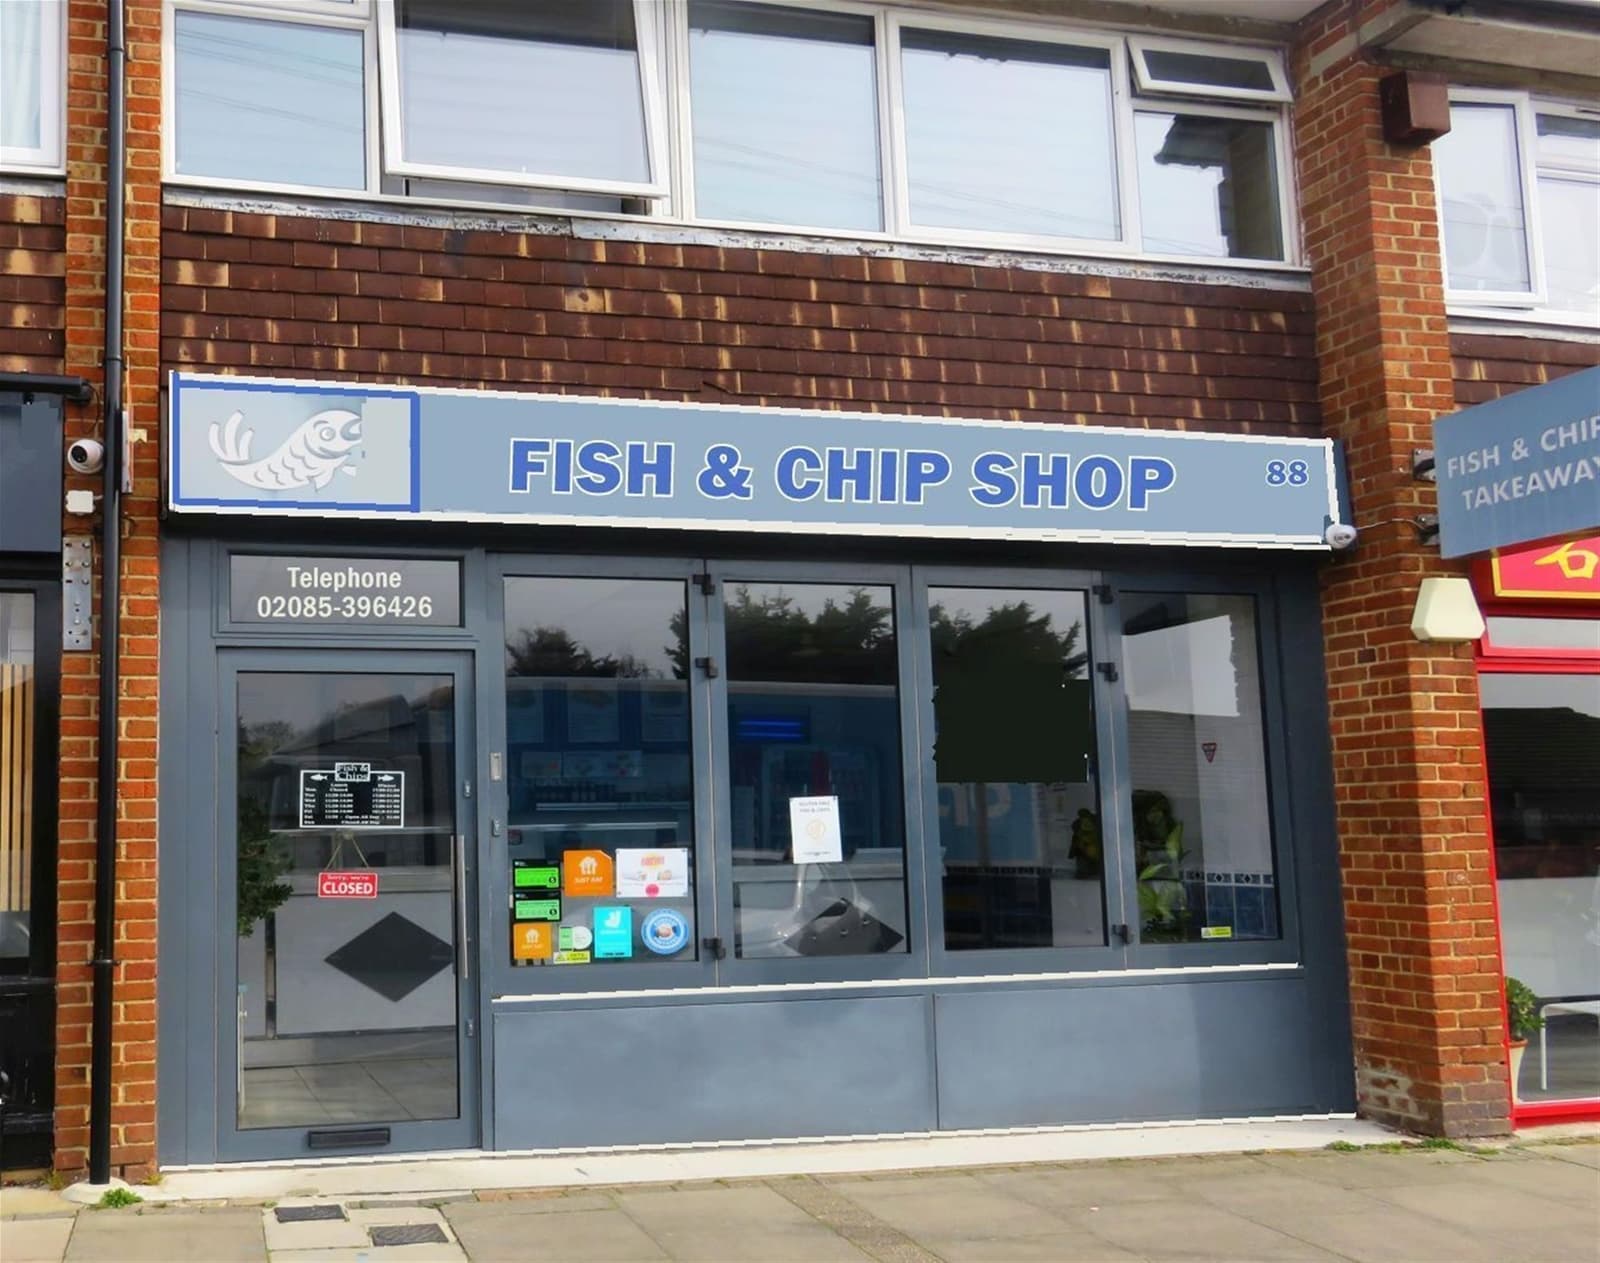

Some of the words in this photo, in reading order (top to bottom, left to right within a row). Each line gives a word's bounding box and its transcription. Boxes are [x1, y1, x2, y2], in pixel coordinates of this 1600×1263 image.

[1447, 445, 1500, 479] FISH
[1511, 437, 1530, 461] &
[509, 438, 675, 498] FISH
[696, 443, 753, 500] &
[775, 445, 952, 505] CHIP
[968, 451, 1176, 512] SHOP
[1264, 459, 1310, 488] 88
[286, 566, 402, 593] Telephone
[256, 595, 433, 618] 02085-396426
[322, 881, 373, 895] CLOSED
